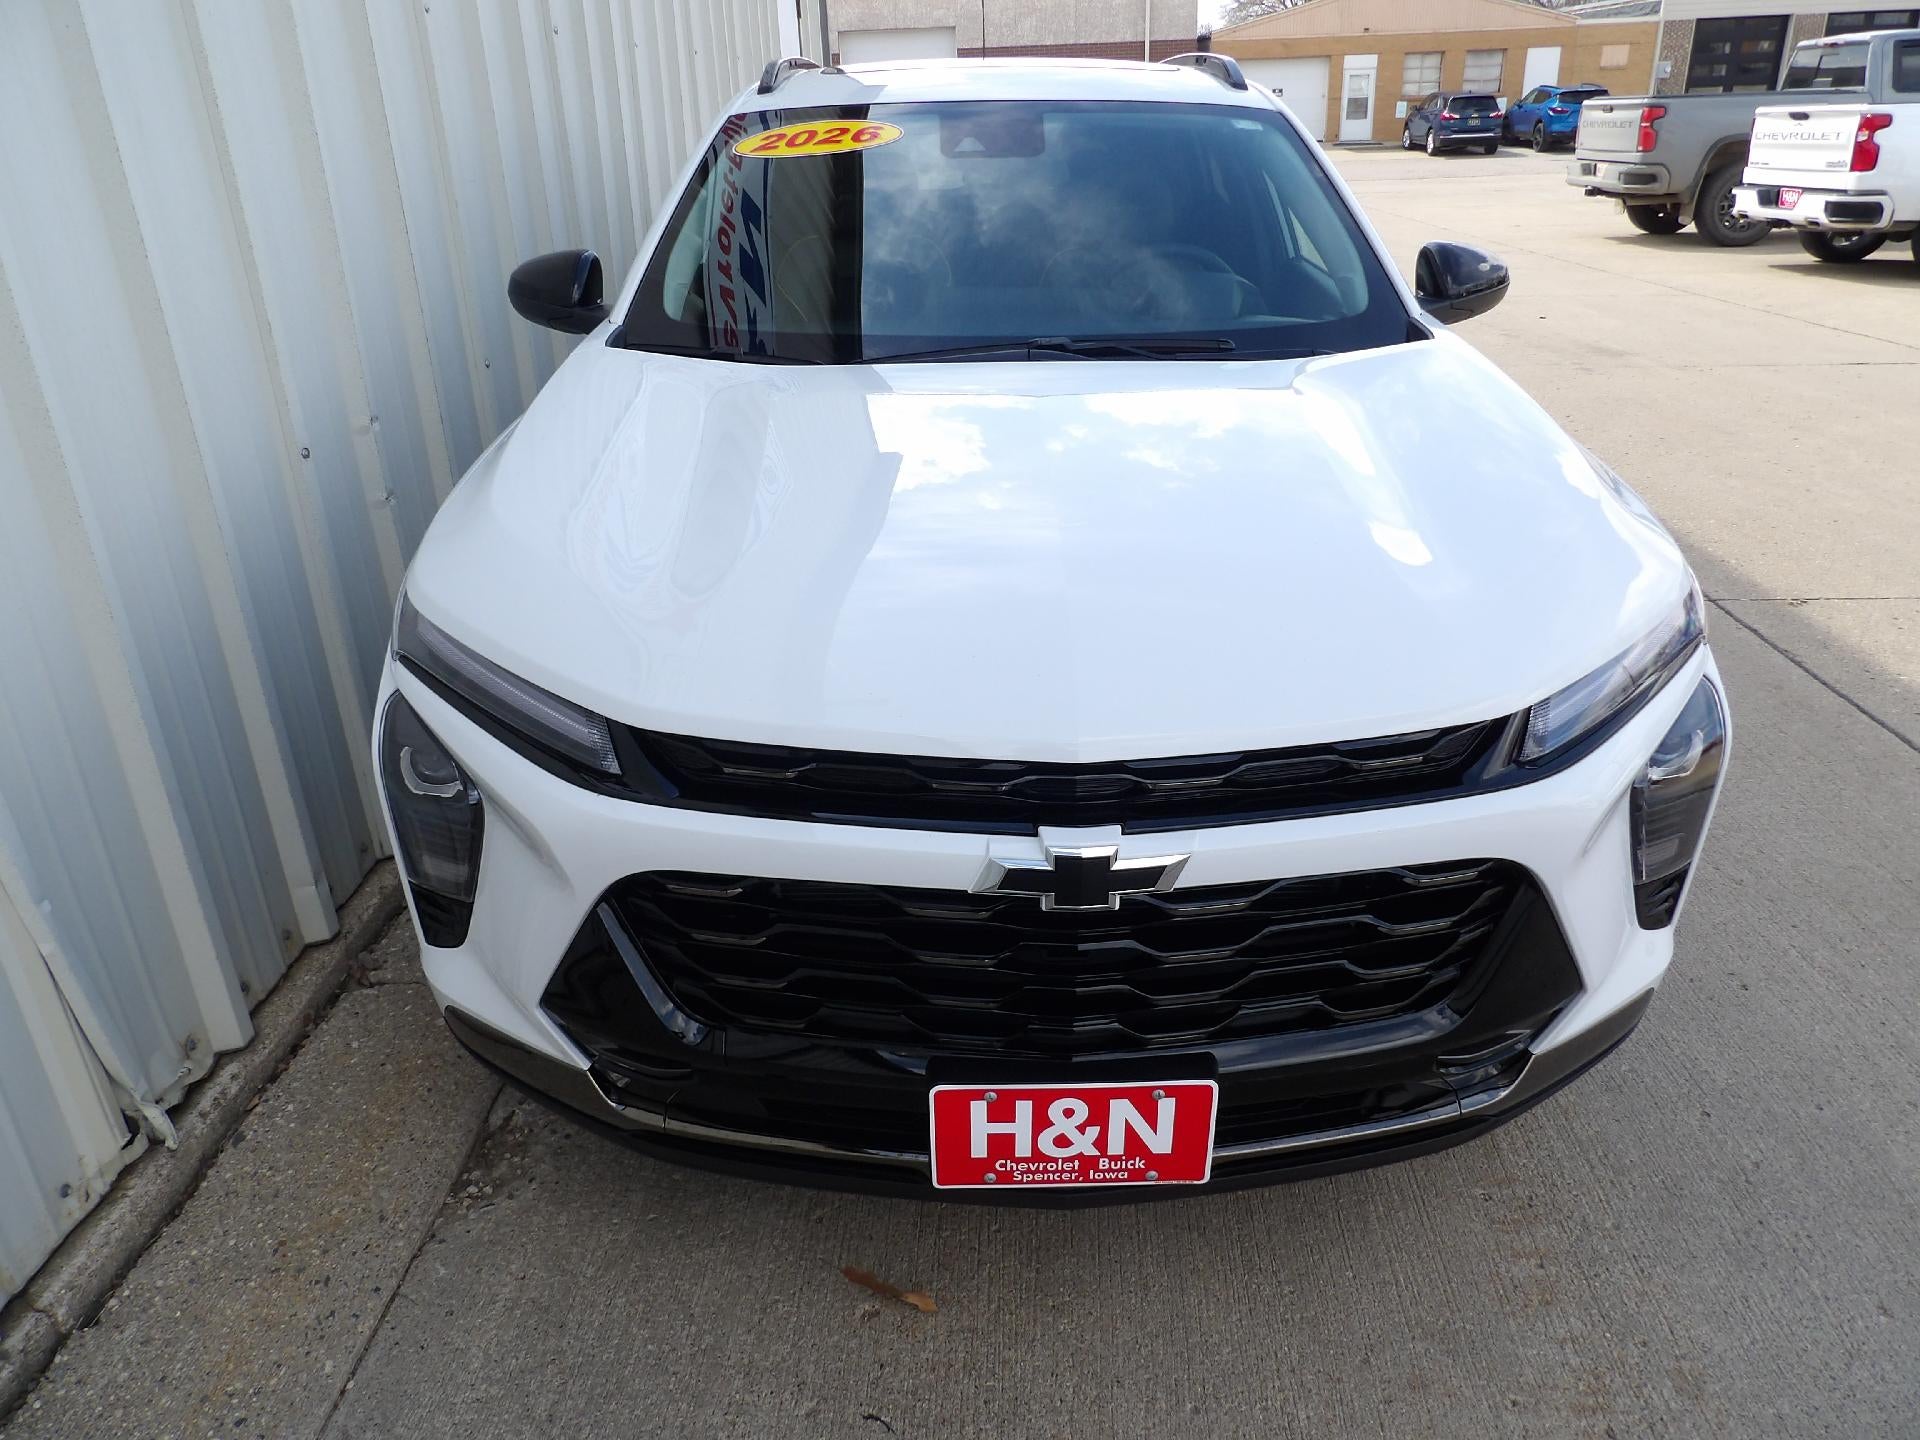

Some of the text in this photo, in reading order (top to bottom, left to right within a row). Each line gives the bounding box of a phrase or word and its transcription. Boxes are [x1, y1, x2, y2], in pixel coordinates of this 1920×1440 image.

[750, 125, 884, 153] 2026
[1755, 131, 1842, 141] CHEVROLET
[970, 1097, 1176, 1158] H&N
[995, 1156, 1146, 1171] Chevrolet Buick
[1013, 1170, 1128, 1183] Spencer, Iowa
